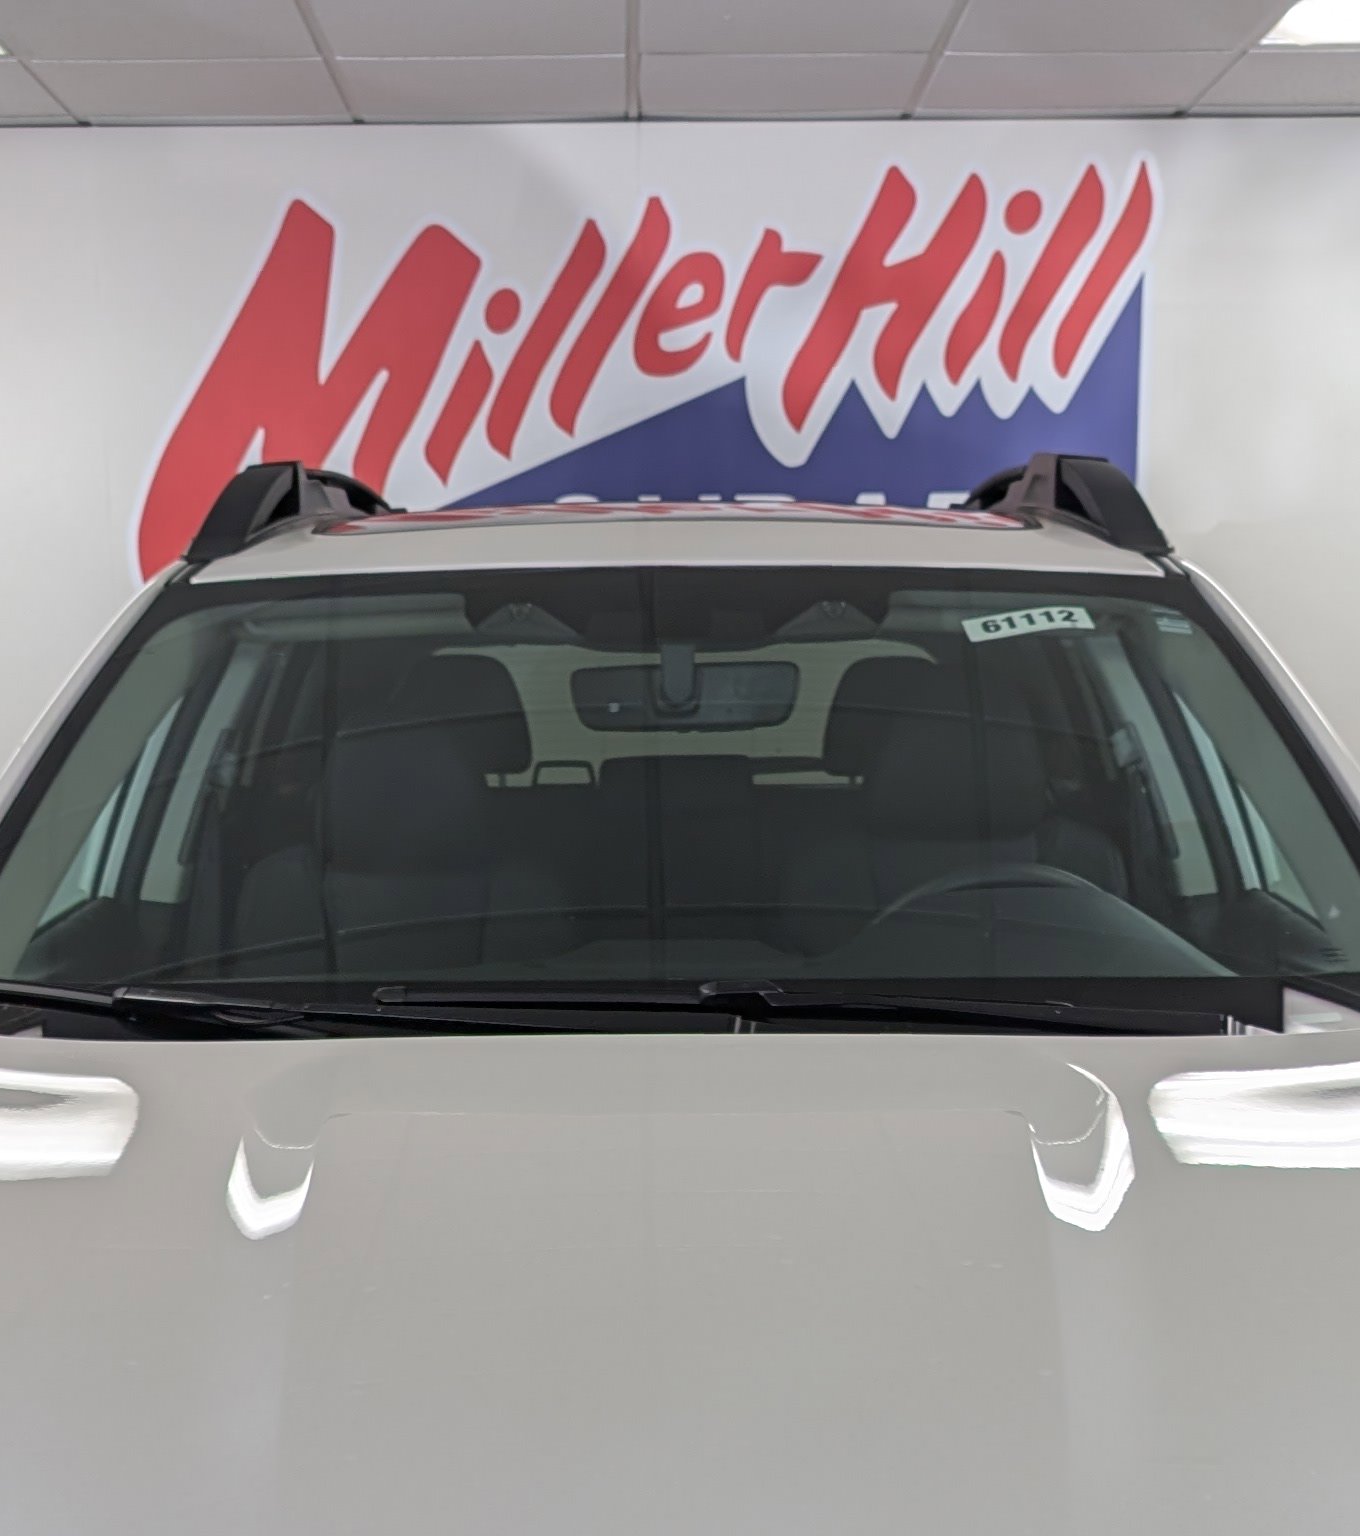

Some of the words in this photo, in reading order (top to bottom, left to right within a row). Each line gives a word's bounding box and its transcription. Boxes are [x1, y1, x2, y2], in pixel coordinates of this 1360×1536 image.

[138, 196, 822, 584] Miller
[782, 160, 1153, 433] Hill
[981, 609, 1078, 634] 61112
